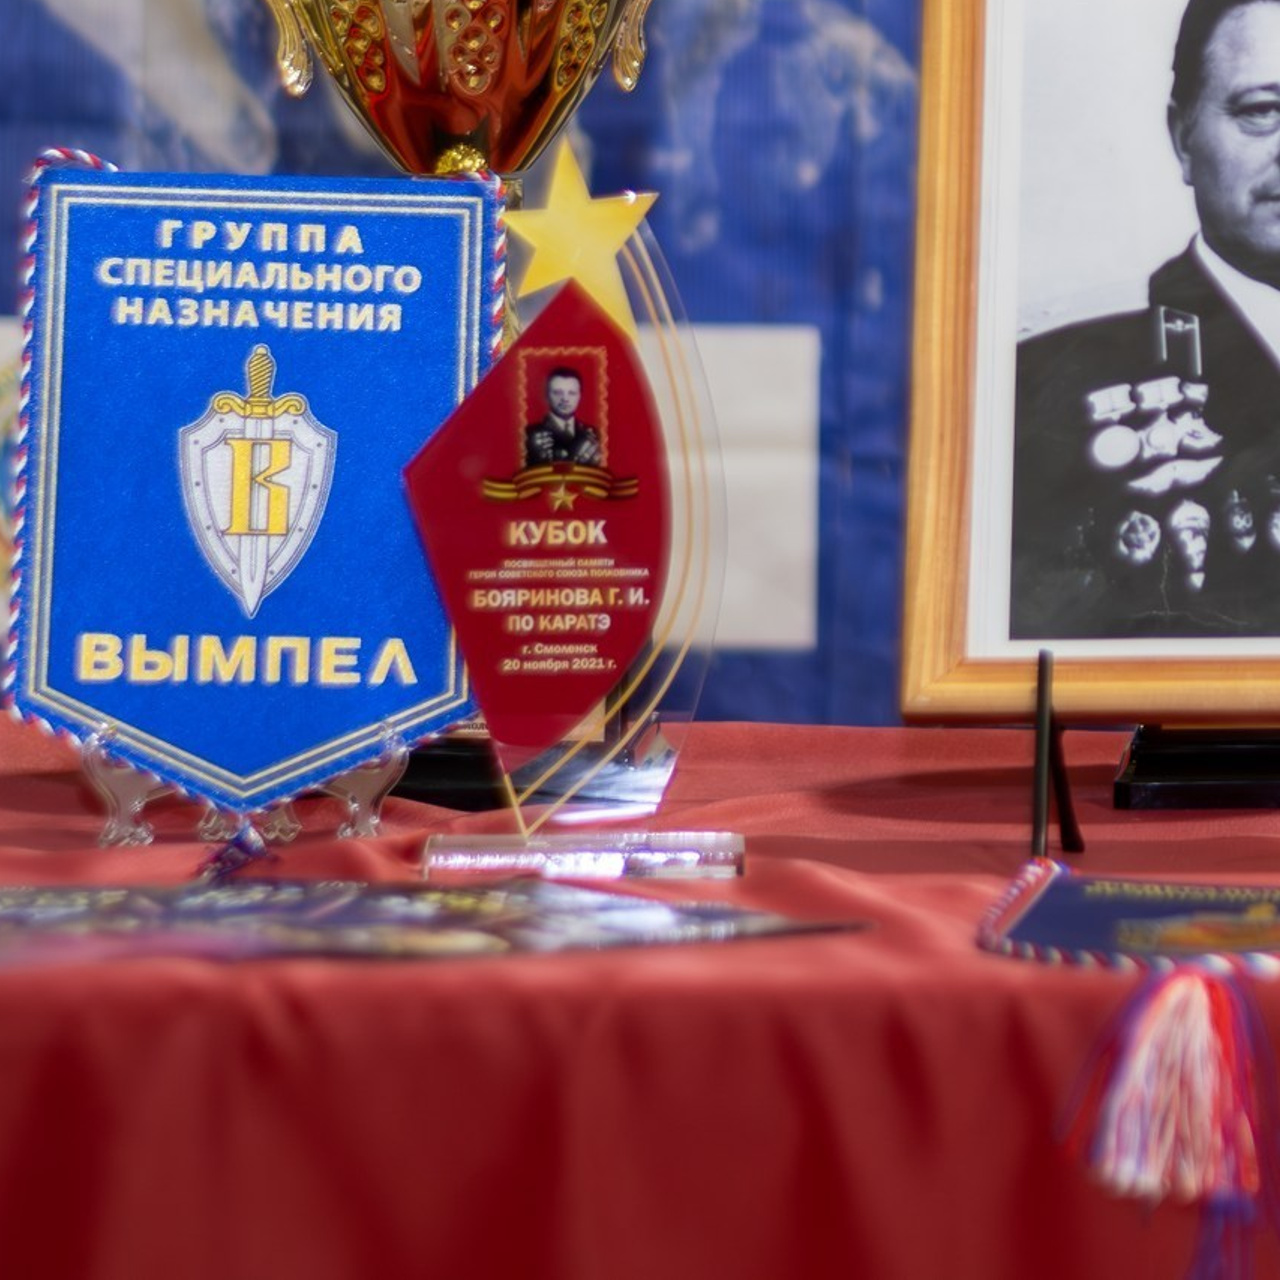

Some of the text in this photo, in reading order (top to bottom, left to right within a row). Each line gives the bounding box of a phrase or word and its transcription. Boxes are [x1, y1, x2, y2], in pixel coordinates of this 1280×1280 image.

[156, 220, 363, 254] ГРУППА
[98, 257, 422, 293] СПЕЦИАЛЬНОГО
[115, 297, 402, 332] НАЗНАЧЕНИЯ
[509, 520, 608, 545] КУБОК
[473, 588, 650, 607] БОЯРИНОВА Г. И.
[508, 614, 611, 631] ПО КАРАТЭ
[78, 632, 418, 687] ВЫМПЕЛ
[534, 642, 599, 655] Смоленск
[503, 659, 520, 670] 20
[523, 658, 569, 672] ноября
[572, 657, 605, 670] 2021
